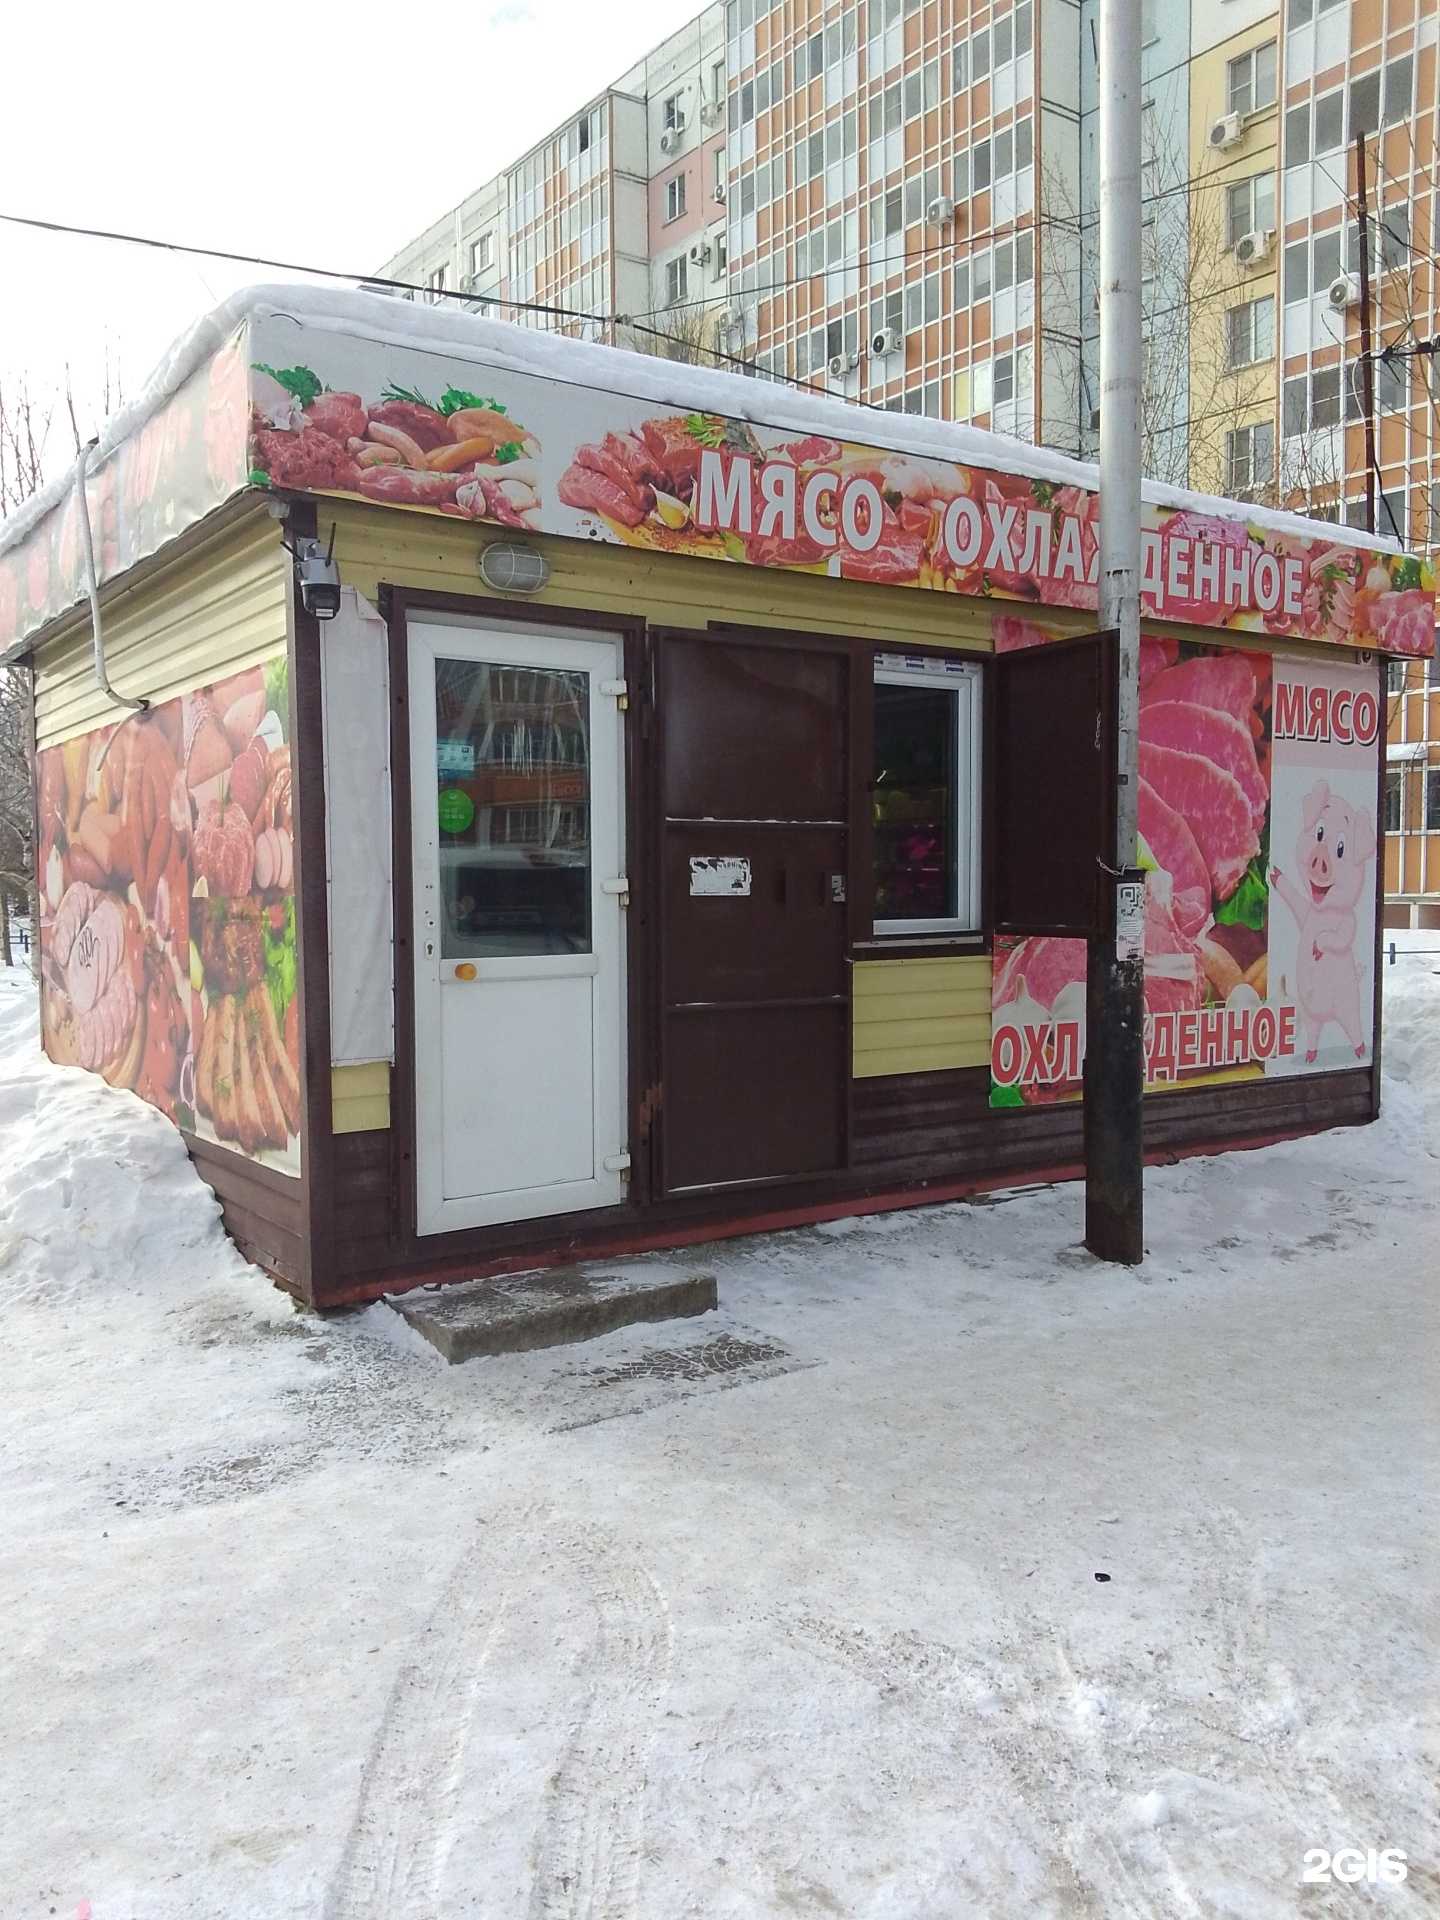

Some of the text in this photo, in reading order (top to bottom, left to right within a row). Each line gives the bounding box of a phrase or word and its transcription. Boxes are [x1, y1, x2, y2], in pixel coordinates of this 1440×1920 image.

[699, 449, 1303, 615] МЯСО ОХЛАДЕННОЕ
[1274, 682, 1379, 744] МЯСО
[990, 1005, 1297, 1085] ОХЛДЕННОЕ
